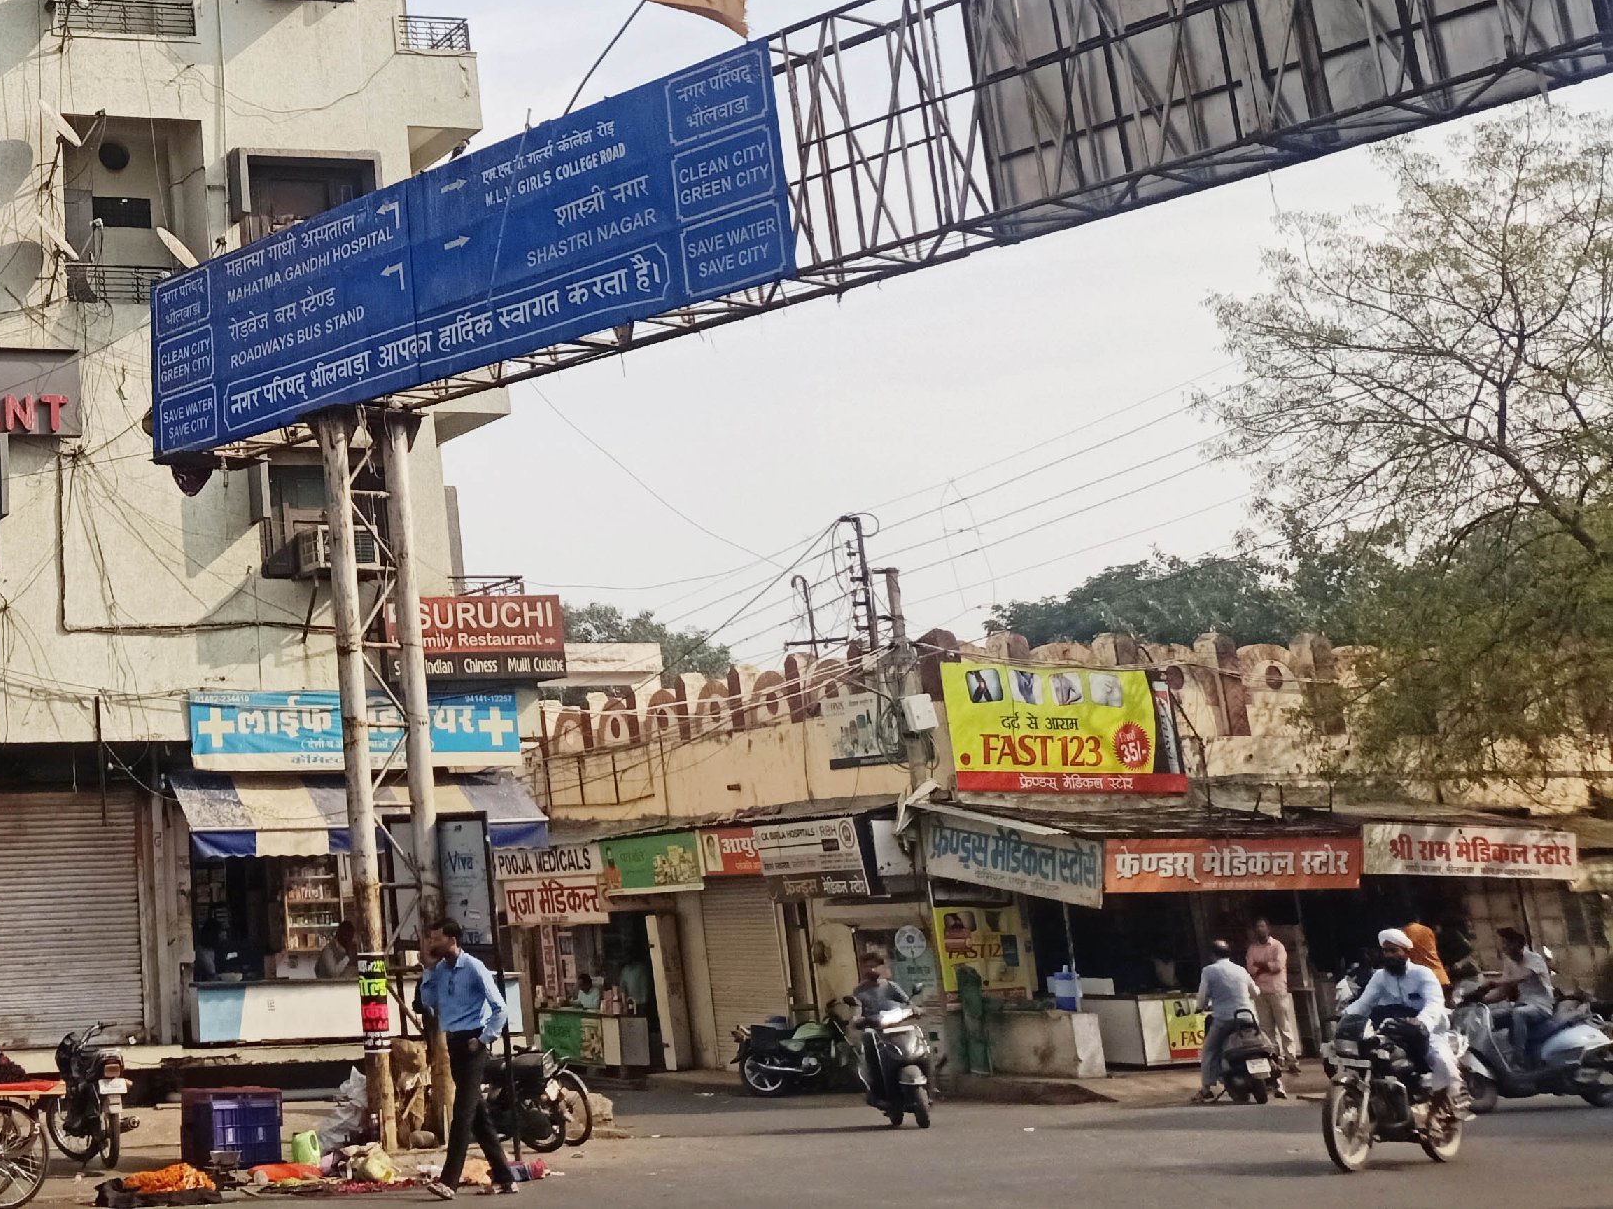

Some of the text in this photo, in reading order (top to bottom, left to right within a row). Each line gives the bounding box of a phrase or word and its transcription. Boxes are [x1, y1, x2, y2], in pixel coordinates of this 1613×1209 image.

[676, 80, 707, 102] नगर
[517, 170, 552, 195] GIRLS
[555, 152, 599, 181] COLLEGE
[599, 142, 626, 166] ROAD
[679, 142, 766, 184] CLEAN CITY
[554, 174, 650, 227] शास्त्री नगर
[680, 163, 770, 205] GREEN CITY
[224, 215, 356, 277] महात्मा गांधी अस्पताल
[526, 208, 657, 267] SHASTRI NAGAR
[688, 217, 776, 259] SAVE WATER
[227, 226, 394, 305] MAHATMA GANDHI HOSPITAL
[698, 243, 769, 278] SAVE CITY
[273, 301, 297, 324] बस
[161, 337, 211, 367] CLEAN CITY
[230, 305, 365, 369] ROADWAYS BUS STAND
[230, 388, 262, 415] नगर
[377, 330, 433, 368] आपका
[438, 310, 493, 353] हार्दिक
[496, 289, 560, 329] स्वागत
[161, 355, 212, 382] GREEN CITY
[163, 397, 214, 424] SAVE WATER
[168, 415, 211, 440] SAVE CITY
[419, 601, 553, 630] SURUCHI
[458, 631, 541, 647] Restaurant
[533, 657, 564, 672] Cuisine
[999, 712, 1080, 731] दर्द से आराम
[1063, 774, 1104, 789] मेडिकल
[498, 852, 534, 875] POOJA
[537, 847, 592, 873] MEDICALS
[1201, 845, 1295, 878] मेडिकल
[1300, 843, 1350, 876] स्टोर
[1388, 833, 1573, 866] श्री राम मेडिकल स्टोर
[506, 888, 535, 923] पूजा
[1180, 1029, 1205, 1047] FAS
